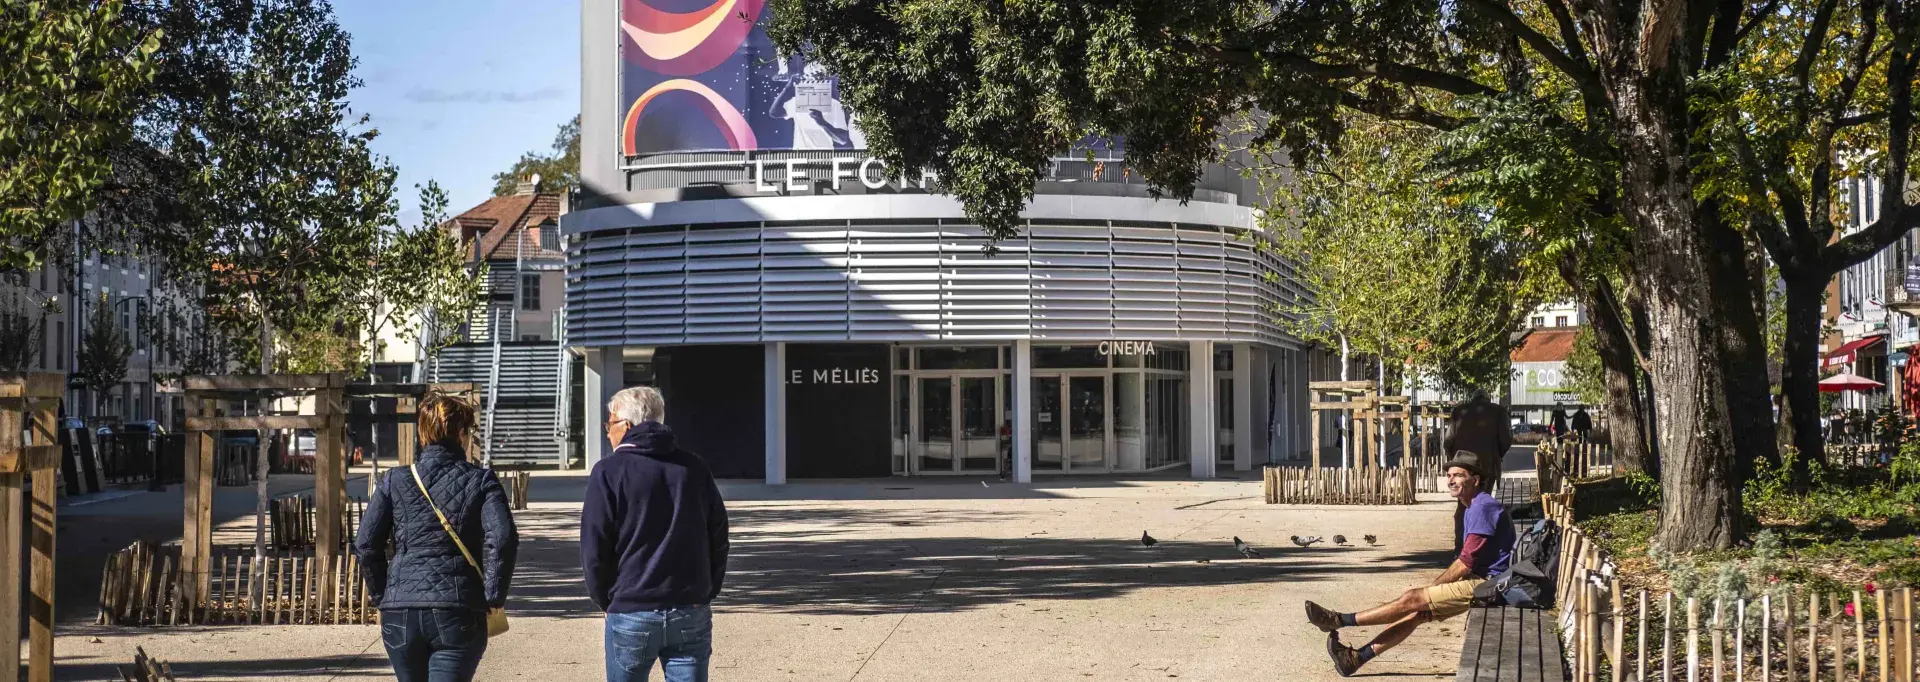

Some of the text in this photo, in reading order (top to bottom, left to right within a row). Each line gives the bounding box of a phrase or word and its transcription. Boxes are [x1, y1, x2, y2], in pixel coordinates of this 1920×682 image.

[756, 158, 809, 192] LE
[1099, 340, 1155, 356] CINEMA
[785, 366, 880, 384] E MÉLIÈS
